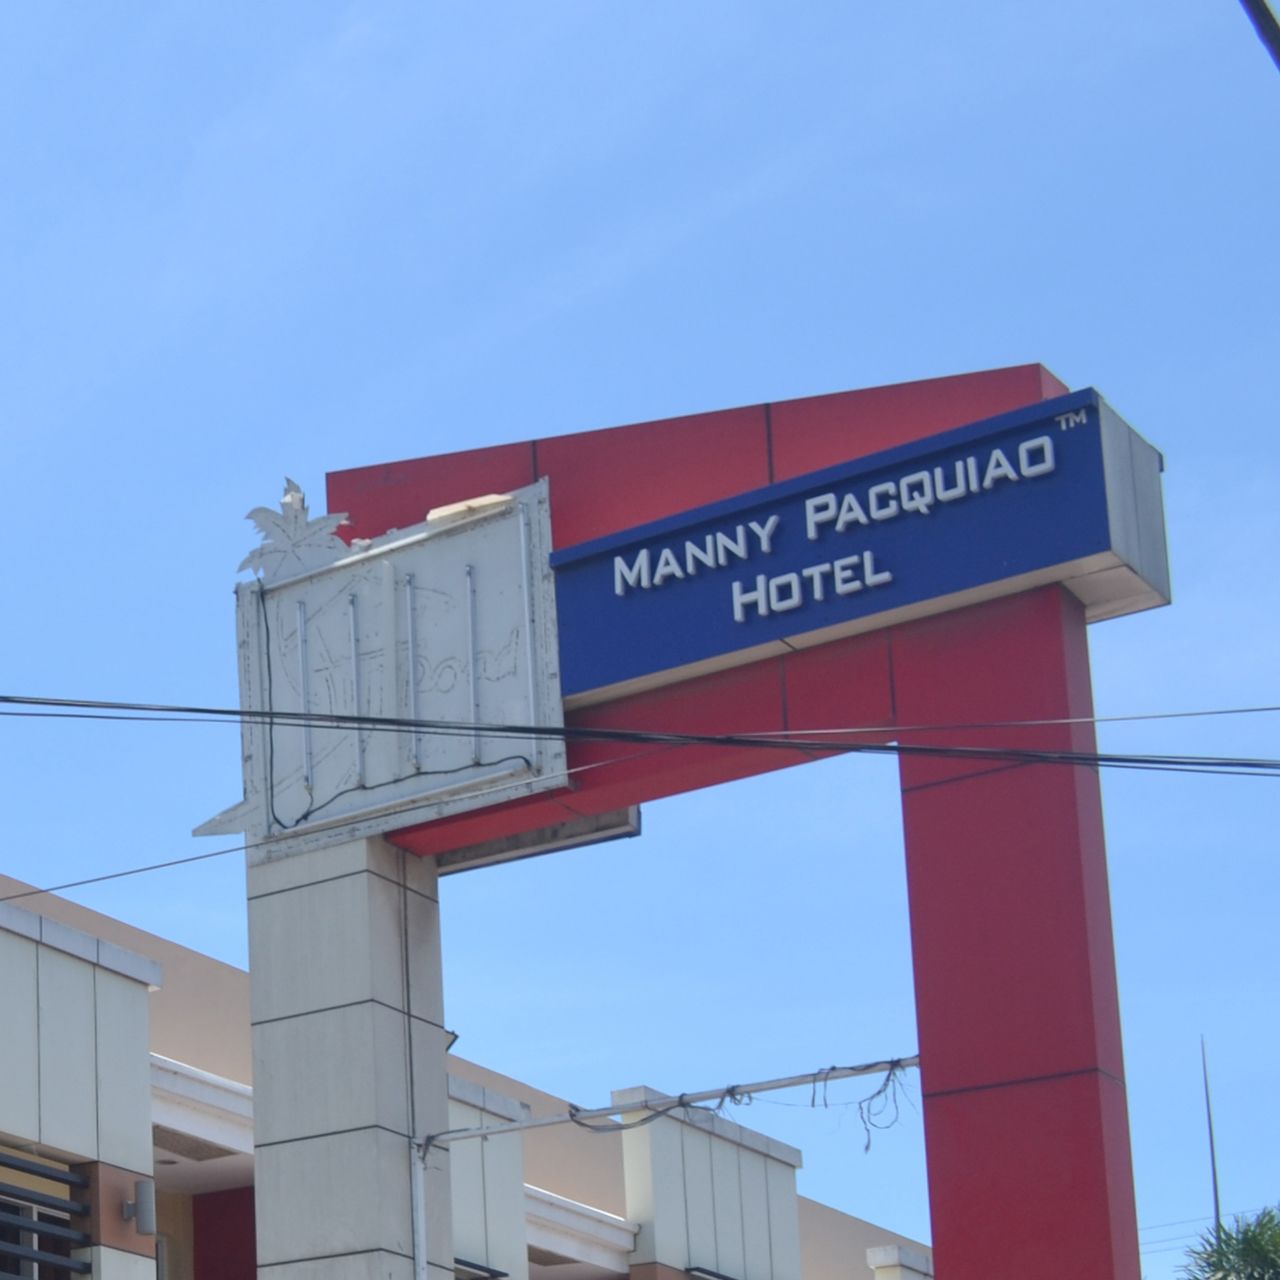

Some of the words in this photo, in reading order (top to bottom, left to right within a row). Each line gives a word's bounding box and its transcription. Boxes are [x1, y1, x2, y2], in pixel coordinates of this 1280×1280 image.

[613, 515, 779, 596] MANNY
[805, 435, 1055, 540] PACQUIAO
[732, 550, 893, 622] HOTEL
